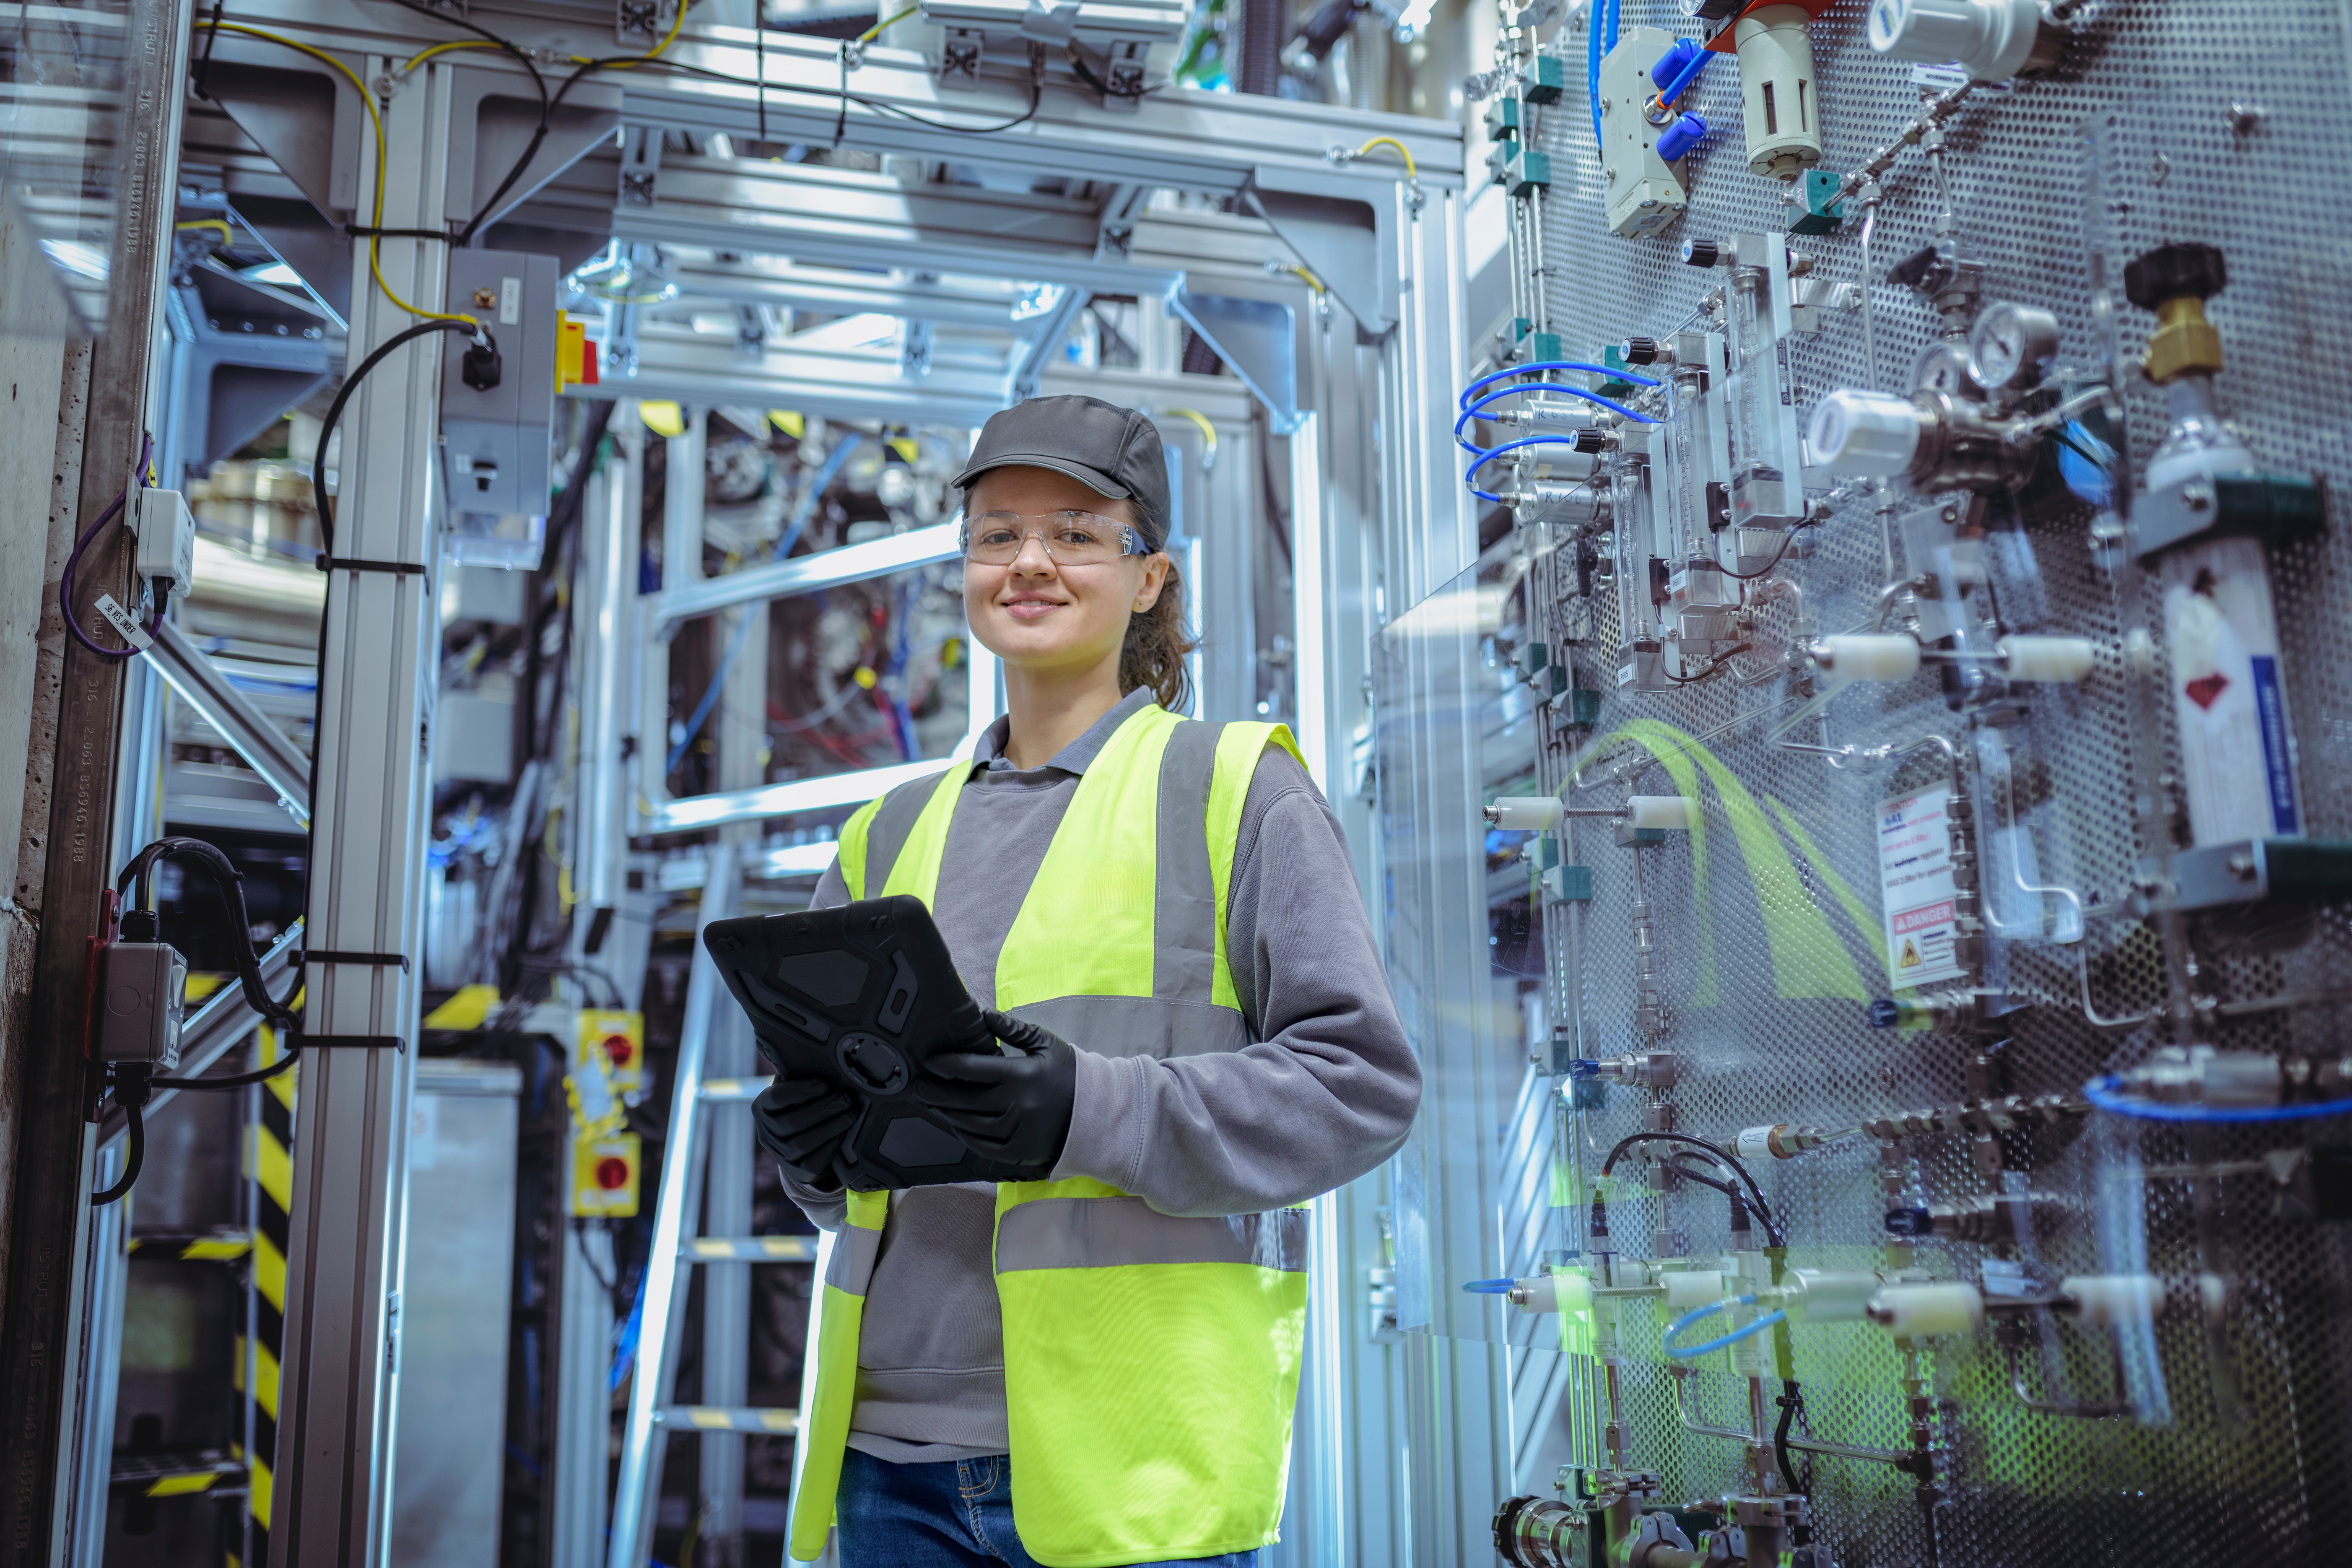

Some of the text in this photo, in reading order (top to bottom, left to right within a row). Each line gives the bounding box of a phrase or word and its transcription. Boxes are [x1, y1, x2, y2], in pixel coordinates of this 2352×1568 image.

[1926, 73, 1952, 82] NOVEMBER
[105, 603, 136, 635] S6_VES_UNDER
[1620, 670, 1629, 680] R605
[1908, 819, 1919, 827] over
[1920, 847, 1945, 861] regulator
[1887, 879, 1900, 889] MAX
[1927, 864, 1953, 878] operation
[1908, 905, 1951, 929] DANGER
[1708, 1177, 1723, 1186] PATCH
